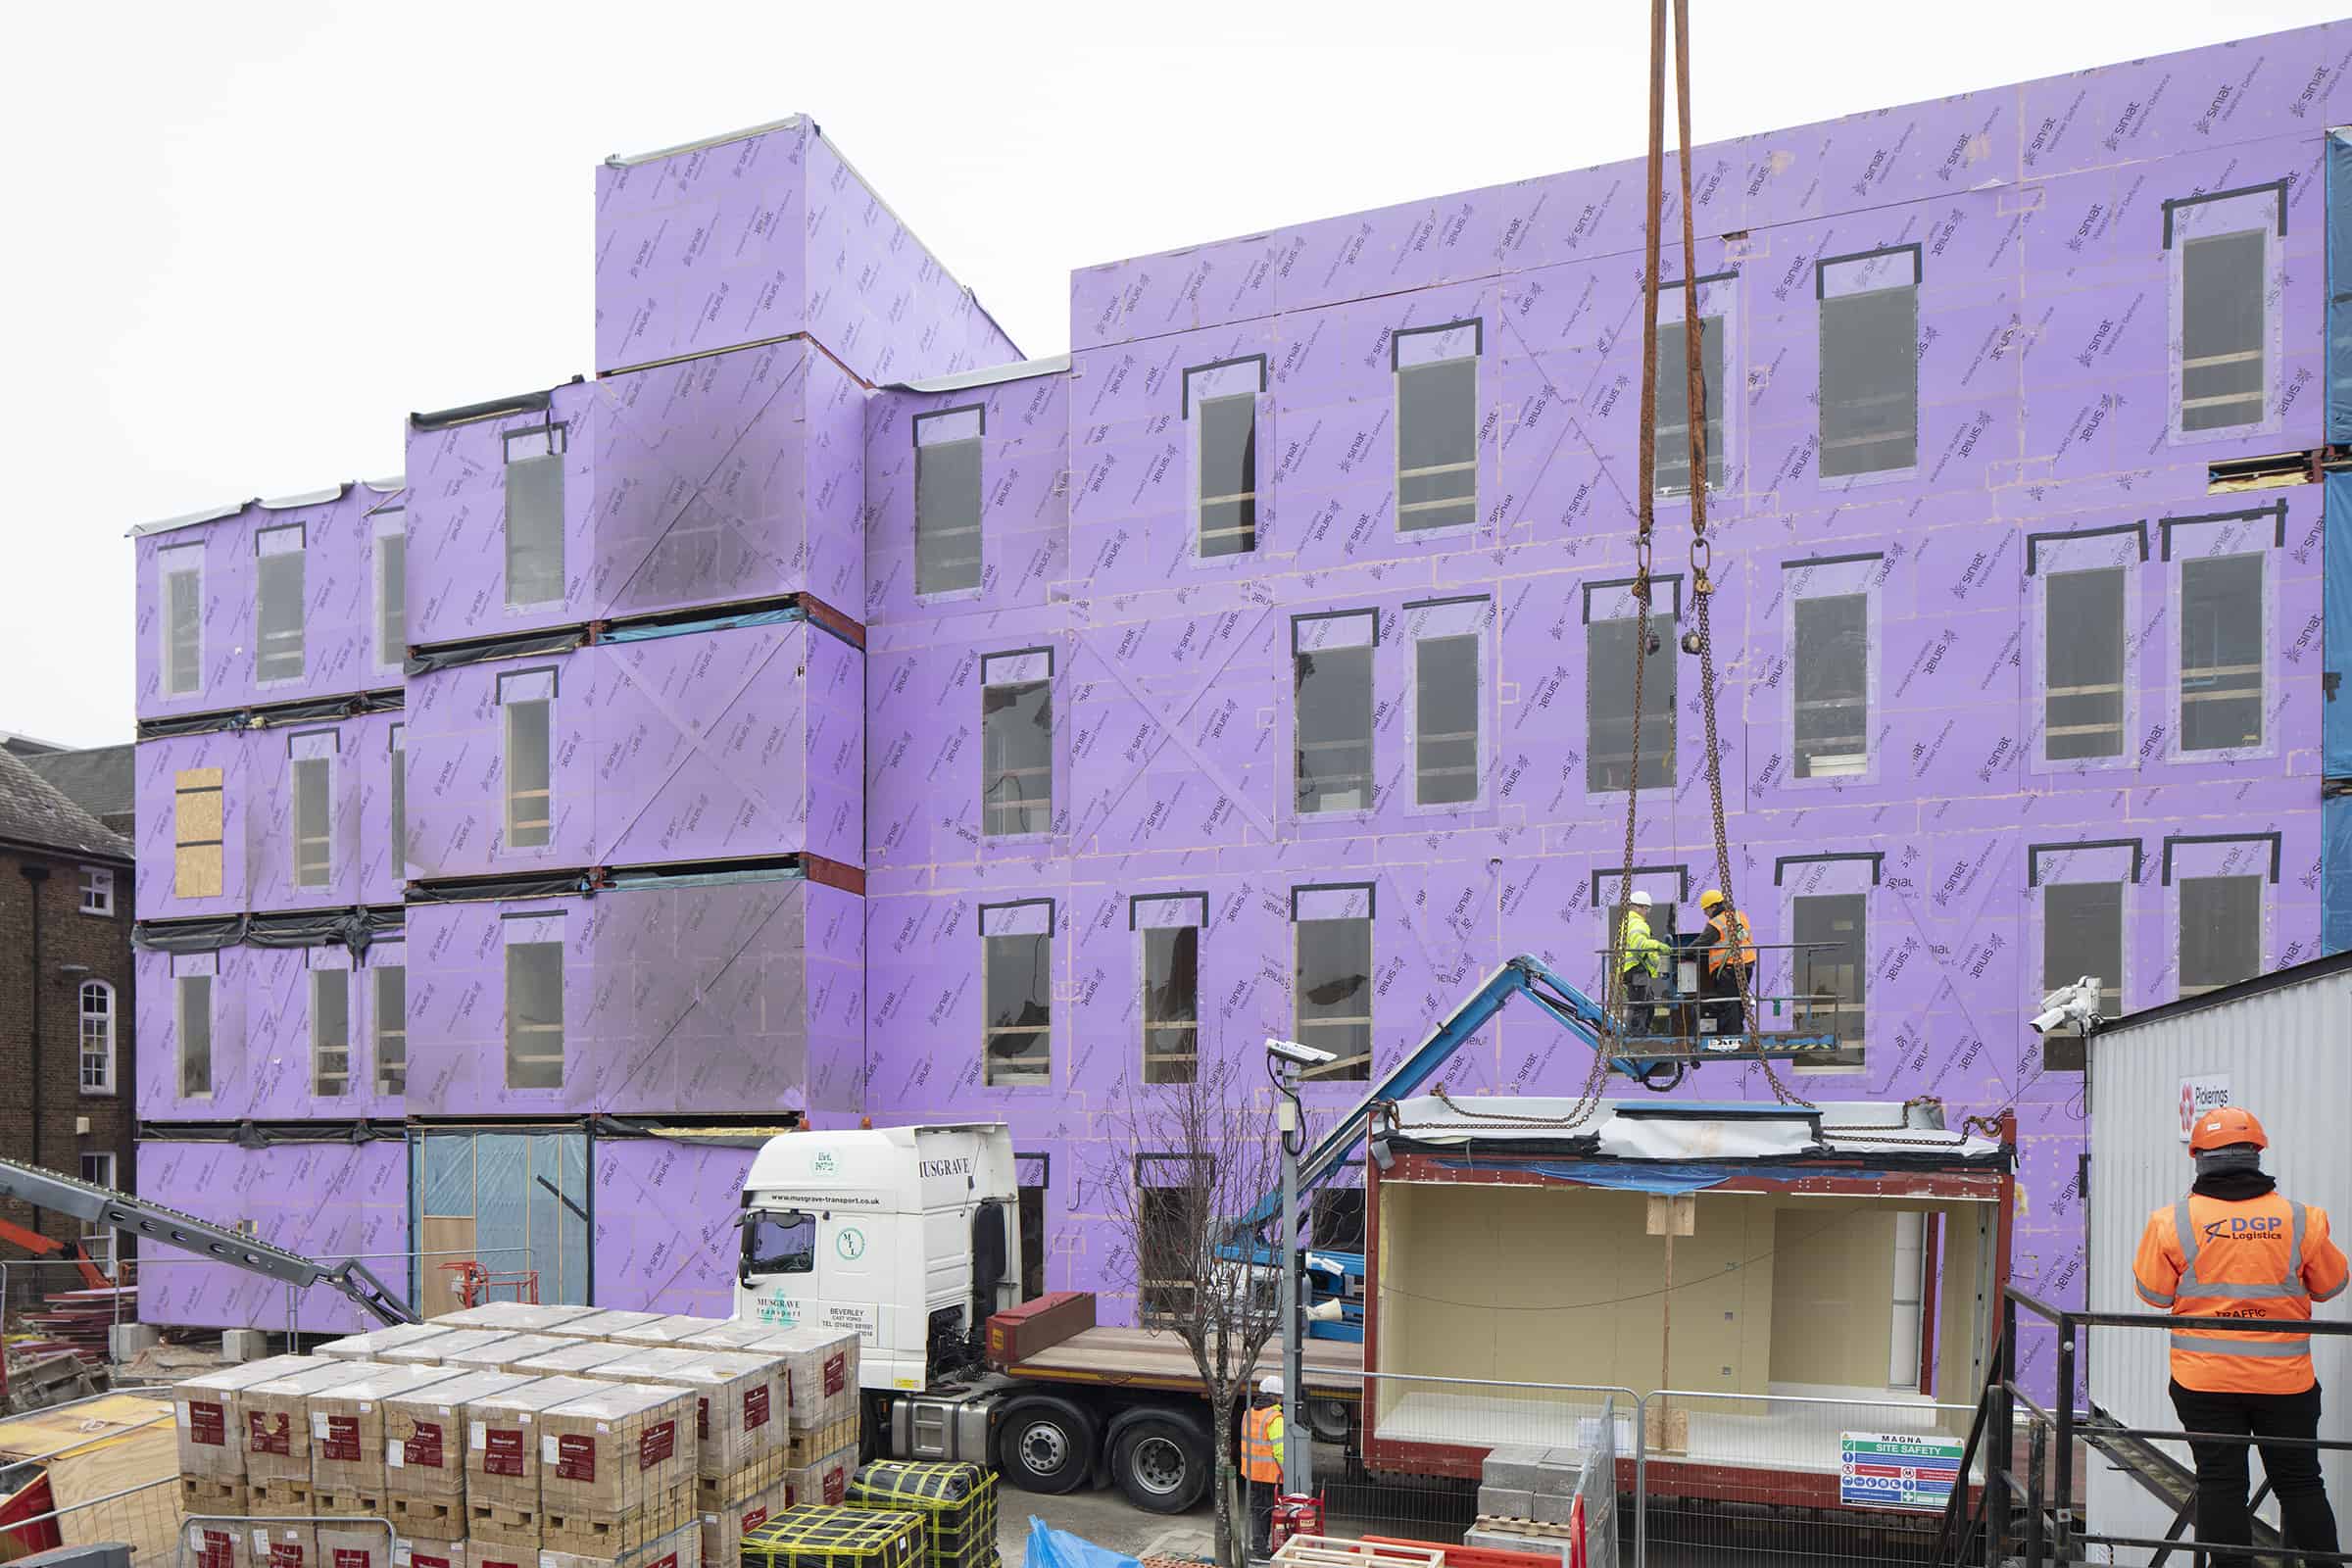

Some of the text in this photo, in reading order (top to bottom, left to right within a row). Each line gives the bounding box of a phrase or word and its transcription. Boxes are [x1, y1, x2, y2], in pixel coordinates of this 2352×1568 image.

[2302, 67, 2329, 103] siniat
[2207, 85, 2232, 121] siniat
[2032, 117, 2056, 151] siniat
[2115, 101, 2140, 138] siniat
[1865, 149, 1886, 181] siniat
[1948, 133, 1972, 167] siniat
[1699, 172, 1721, 206] siniat
[1748, 165, 1770, 197] siniat
[2079, 203, 2103, 238] siniat
[1932, 217, 1956, 256] siniat
[1784, 255, 1807, 290] siniat
[1373, 326, 1392, 358] siniat
[2089, 318, 2114, 352] siniat
[1284, 342, 1302, 369] siniat
[1526, 397, 1547, 428] siniat
[1600, 387, 1622, 417] siniat
[2275, 383, 2300, 416] siniat
[1479, 411, 1497, 439] siniat
[2080, 405, 2106, 442] siniat
[1282, 442, 1300, 468] siniat
[1348, 431, 1367, 462] siniat
[1960, 422, 1983, 458] siniat
[1791, 447, 1812, 479] siniat
[1571, 483, 1590, 513] siniat
[1314, 510, 1335, 542] siniat
[1350, 513, 1370, 543] siniat
[1793, 562, 1813, 595] siniat
[1876, 554, 1898, 588] siniat
[1963, 552, 1986, 590] siniat
[1180, 622, 1198, 649] siniat
[1221, 611, 1239, 640] siniat
[1381, 612, 1397, 640] siniat
[2298, 612, 2324, 646] siniat
[1923, 644, 1945, 674] siniat
[1541, 679, 1561, 710] siniat
[1211, 710, 1230, 740] siniat
[2140, 723, 2165, 758] siniat
[1988, 736, 2012, 769] siniat
[1501, 766, 1521, 797] siniat
[1761, 753, 1781, 784] siniat
[1208, 798, 1228, 825] siniat
[1804, 862, 1828, 894] siniat
[1945, 860, 1968, 894] siniat
[1227, 892, 1245, 921] siniat
[1455, 887, 1475, 915] siniat
[1569, 880, 1589, 912] siniat
[1886, 952, 1909, 982] siniat
[1970, 947, 1994, 980] siniat
[1229, 980, 1248, 1006] siniat
[1377, 968, 1396, 997] siniat
[1446, 1055, 1465, 1082] siniat
[1519, 1052, 1540, 1082] siniat
[1960, 1040, 1983, 1071] siniat
[2017, 1044, 2039, 1075] siniat
[2195, 1086, 2229, 1106] Pickerings
[771, 1193, 881, 1207] www.musgrave-transport.co.uk
[2231, 1217, 2281, 1231] DGP
[2232, 1233, 2281, 1242] Logistics
[2055, 1253, 2079, 1292] siniat
[758, 1298, 801, 1309] MUSGRAVE
[830, 1308, 864, 1317] BEVERLEY
[1876, 1444, 1942, 1456] SITE SAFETY
[1882, 1436, 1922, 1445] MAGNA
